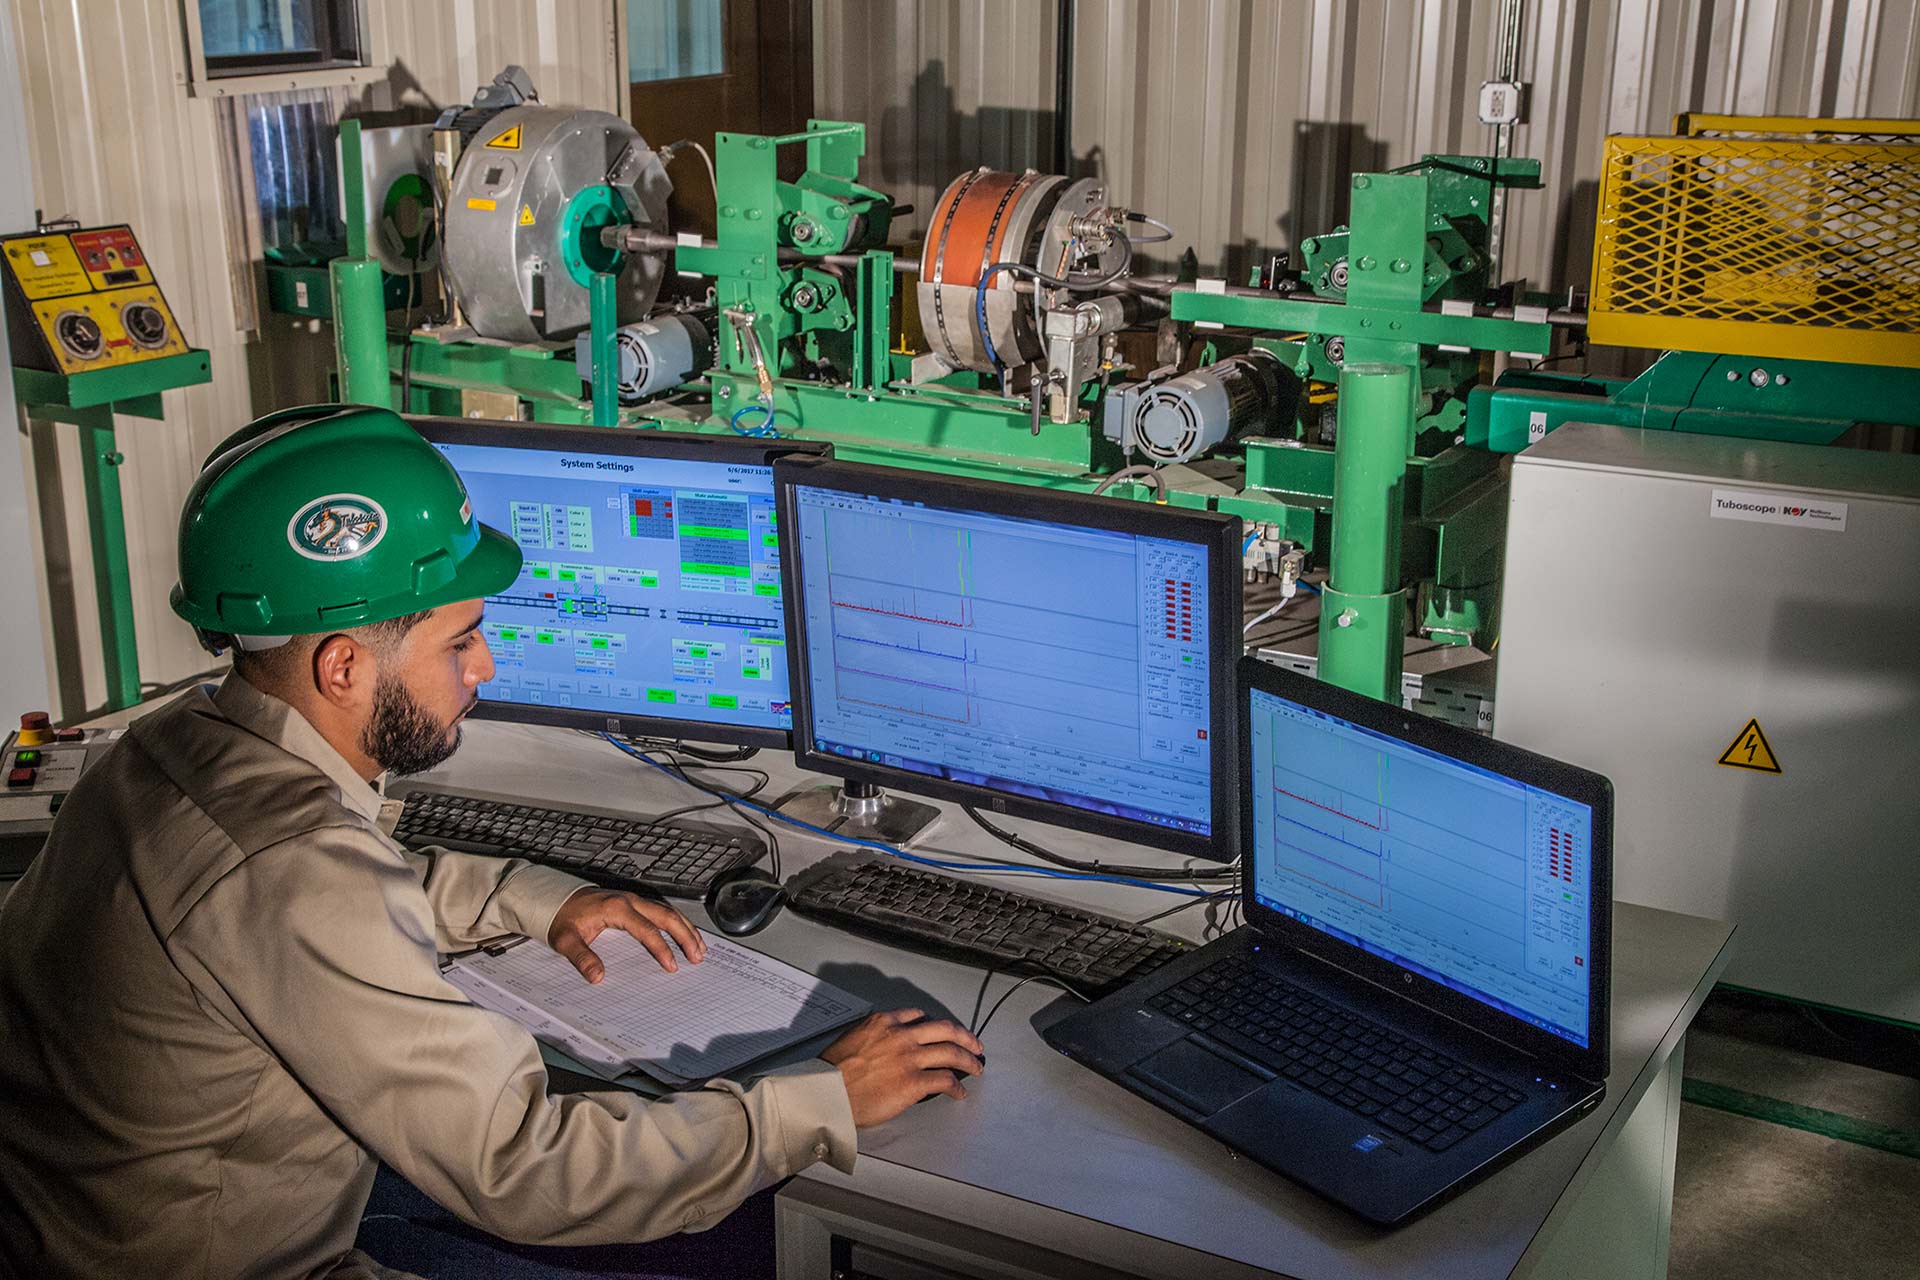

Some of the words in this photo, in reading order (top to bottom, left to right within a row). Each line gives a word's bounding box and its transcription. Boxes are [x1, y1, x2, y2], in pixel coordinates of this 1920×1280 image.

[1530, 424, 1544, 434] 06
[560, 458, 594, 470] System
[596, 461, 634, 472] Settings
[1716, 499, 1776, 514] Tuboscope
[1480, 711, 1492, 721] 06
